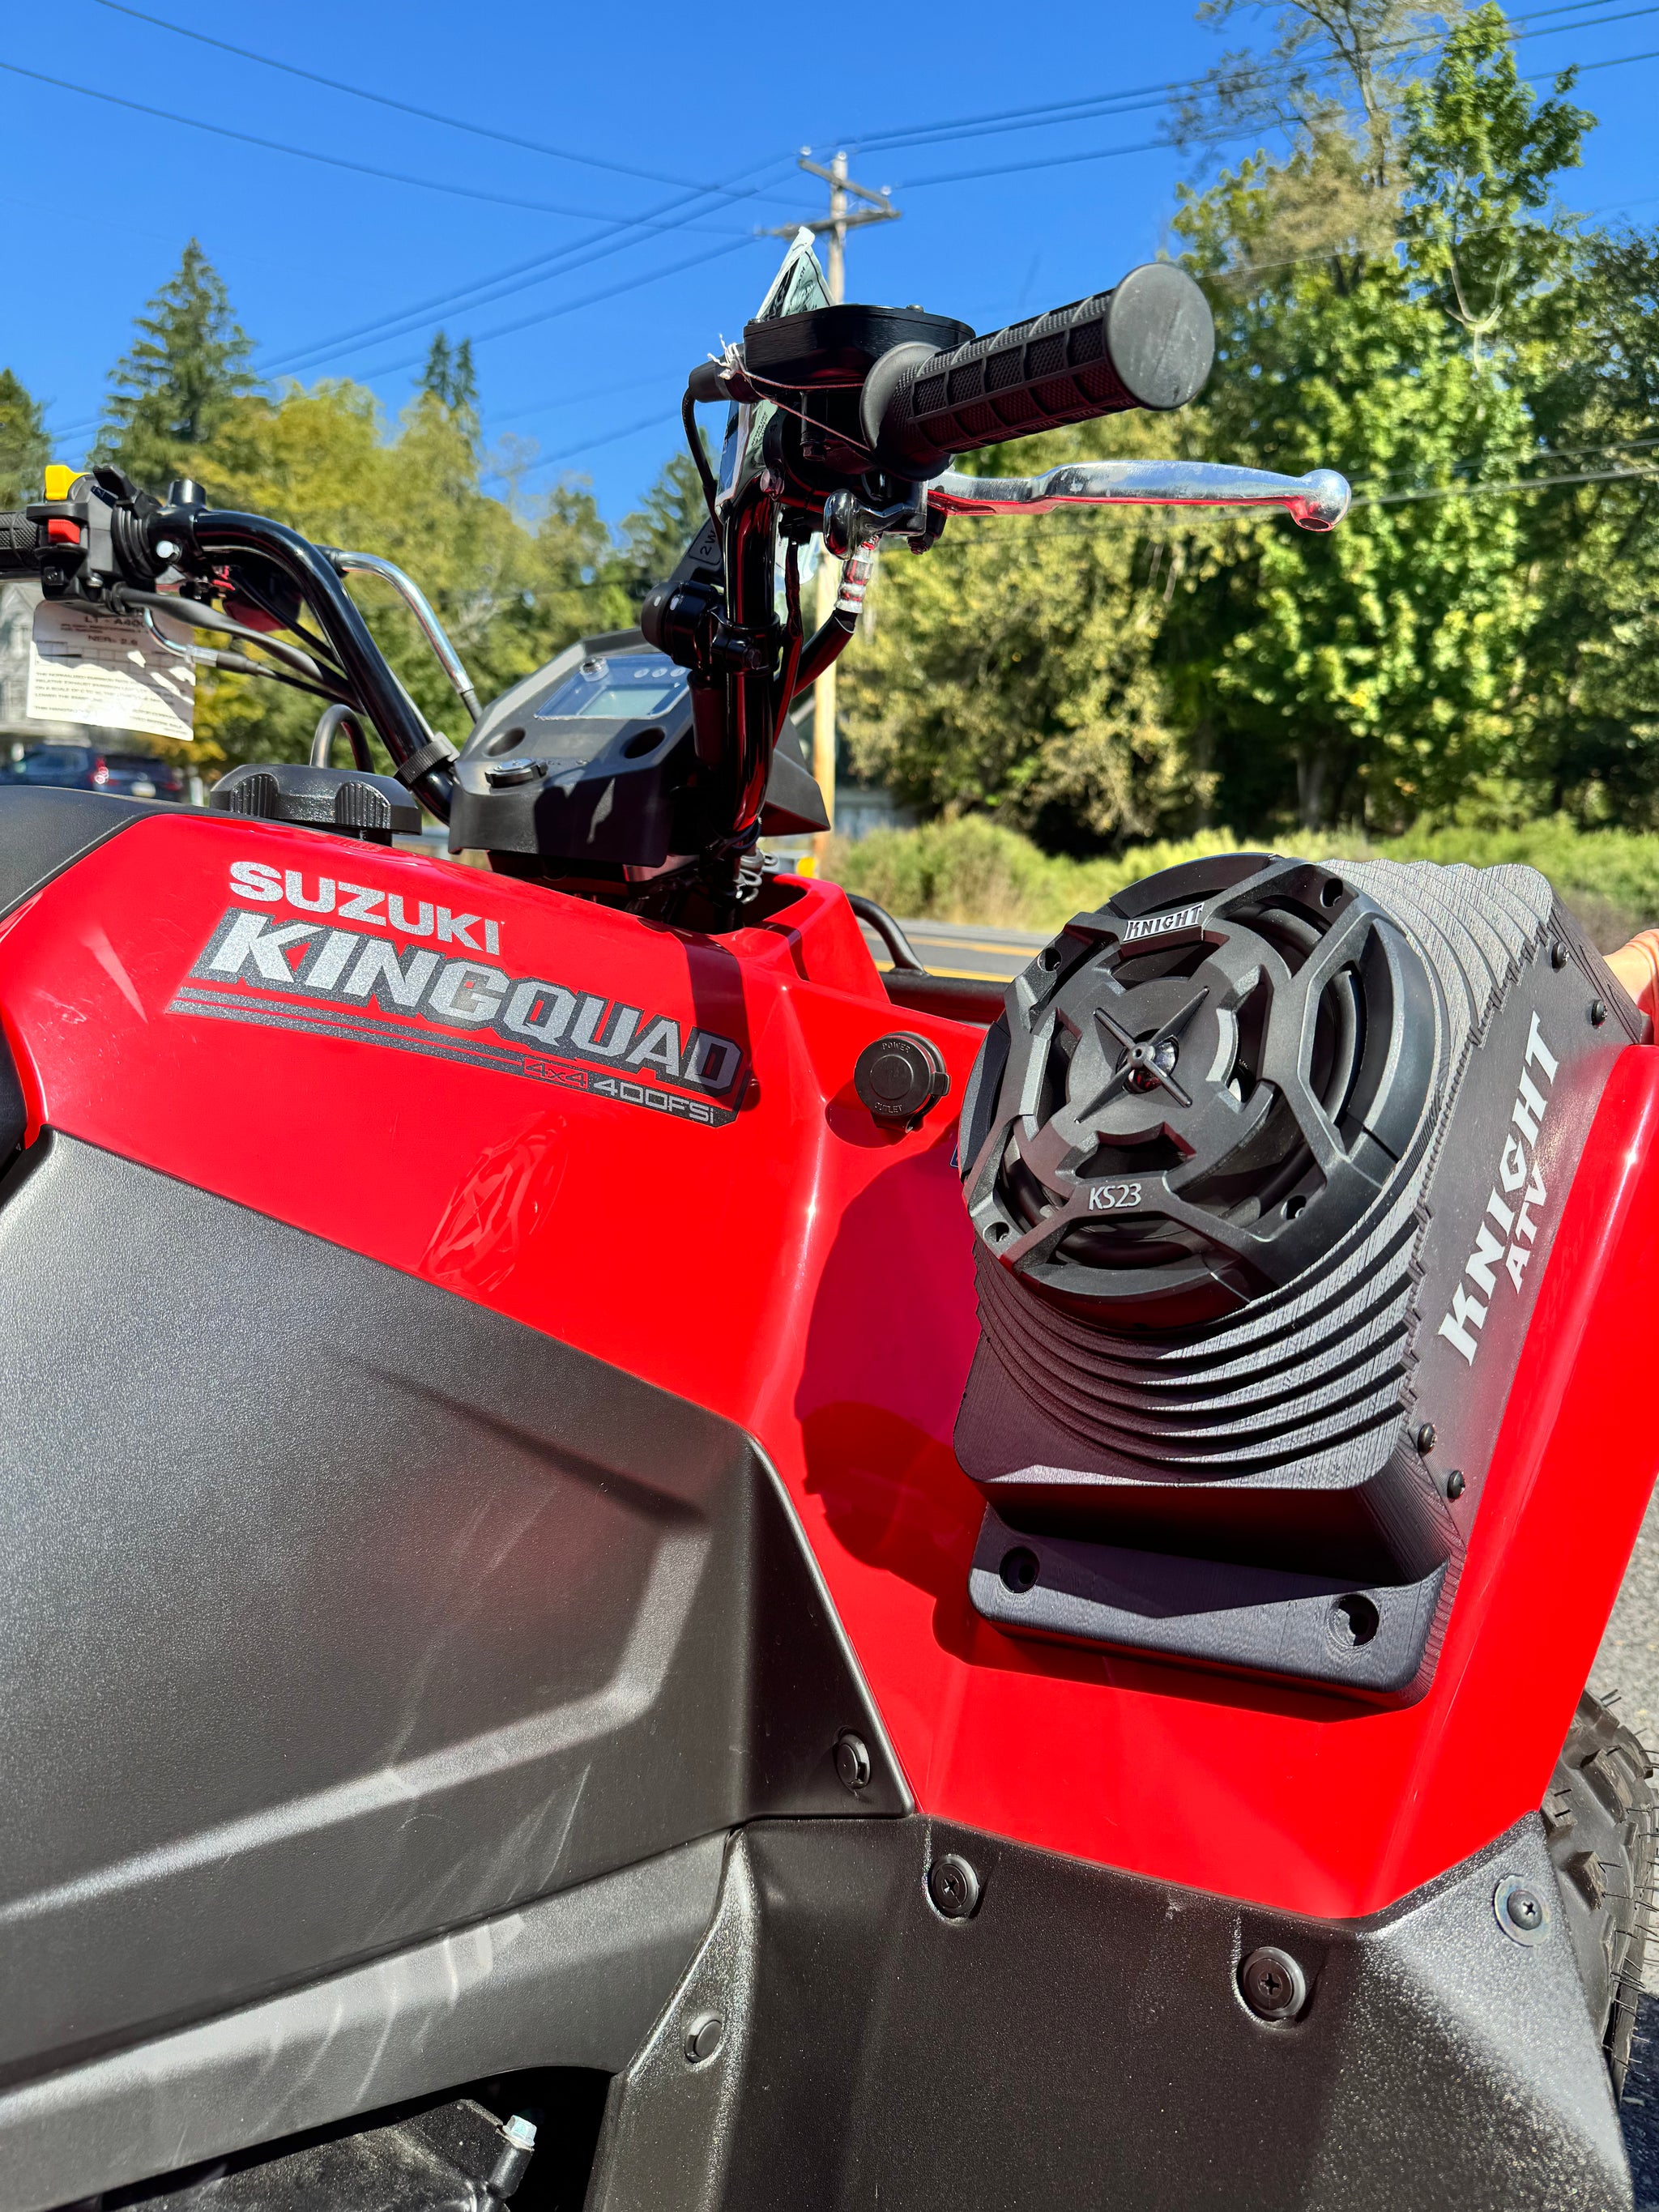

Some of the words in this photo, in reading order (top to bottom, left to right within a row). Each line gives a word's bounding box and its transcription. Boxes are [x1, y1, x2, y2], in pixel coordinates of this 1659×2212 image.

[230, 861, 501, 955] SUZUKI
[1124, 903, 1204, 940] KNIGHT
[208, 913, 742, 1089] KINGQUAD
[881, 1042, 911, 1054] POWER
[526, 1061, 587, 1088] 4x4
[593, 1079, 714, 1124] 400FSi
[875, 1102, 903, 1114] OUTLET
[1089, 1183, 1142, 1210] KS23
[1438, 1010, 1559, 1366] KNIGHT
[1505, 1161, 1548, 1295] ATV
